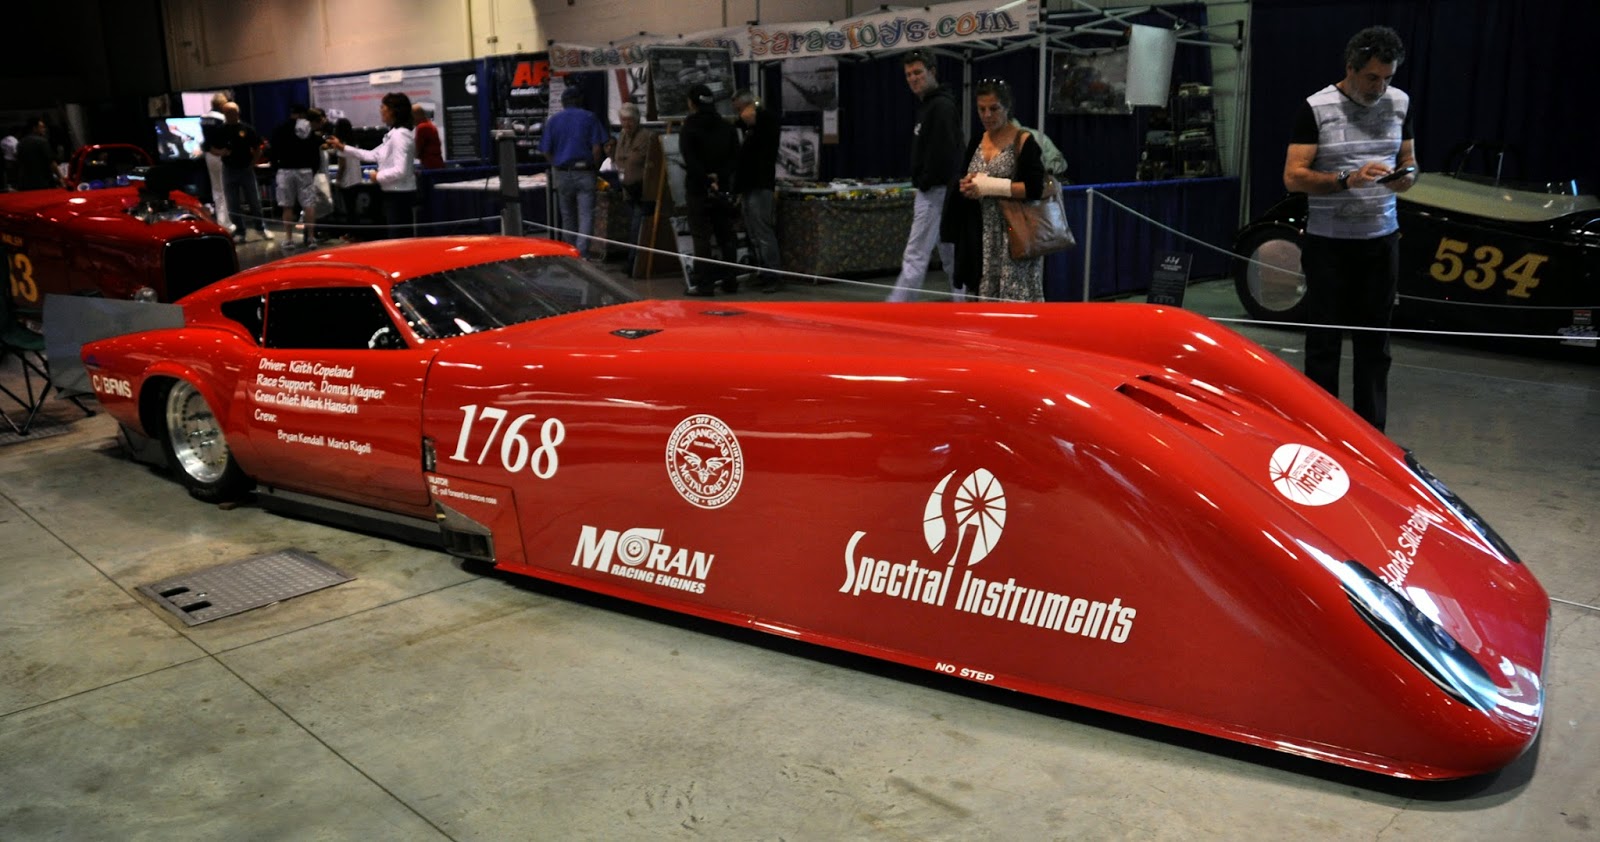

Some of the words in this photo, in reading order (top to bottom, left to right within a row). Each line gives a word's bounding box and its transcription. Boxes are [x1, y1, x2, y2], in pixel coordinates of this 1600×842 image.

[1430, 237, 1549, 298] 534
[259, 357, 286, 371] Driver:
[289, 360, 313, 374] Keith
[313, 362, 354, 380] Copeland
[256, 373, 277, 387] Race
[278, 376, 316, 393] Support:
[320, 380, 348, 396] Donna
[349, 383, 385, 401] Wagner
[254, 389, 275, 403] Crew
[276, 392, 300, 406] Chief:
[301, 395, 323, 409] Mark
[323, 400, 358, 414] Hanson
[254, 408, 277, 422] Crew:
[696, 417, 709, 425] OFF
[710, 419, 728, 436] ROAD
[277, 429, 298, 443] Bryan
[298, 432, 324, 446] Kendall
[327, 437, 349, 450] Mario
[449, 404, 566, 479] 1768
[668, 420, 691, 461] LANDSPEED
[730, 441, 741, 480] VINTAGE
[671, 471, 686, 493] RODS
[707, 481, 737, 506] RACECARS
[686, 492, 700, 503] HOT
[571, 525, 715, 580] MORAN
[1398, 525, 1423, 557] Salt
[611, 564, 654, 583] RACING
[655, 574, 706, 595] ENGINES
[839, 530, 955, 606] Spectral
[955, 569, 1137, 644] Instruments
[934, 662, 956, 674] NO
[959, 667, 995, 682] STEP
